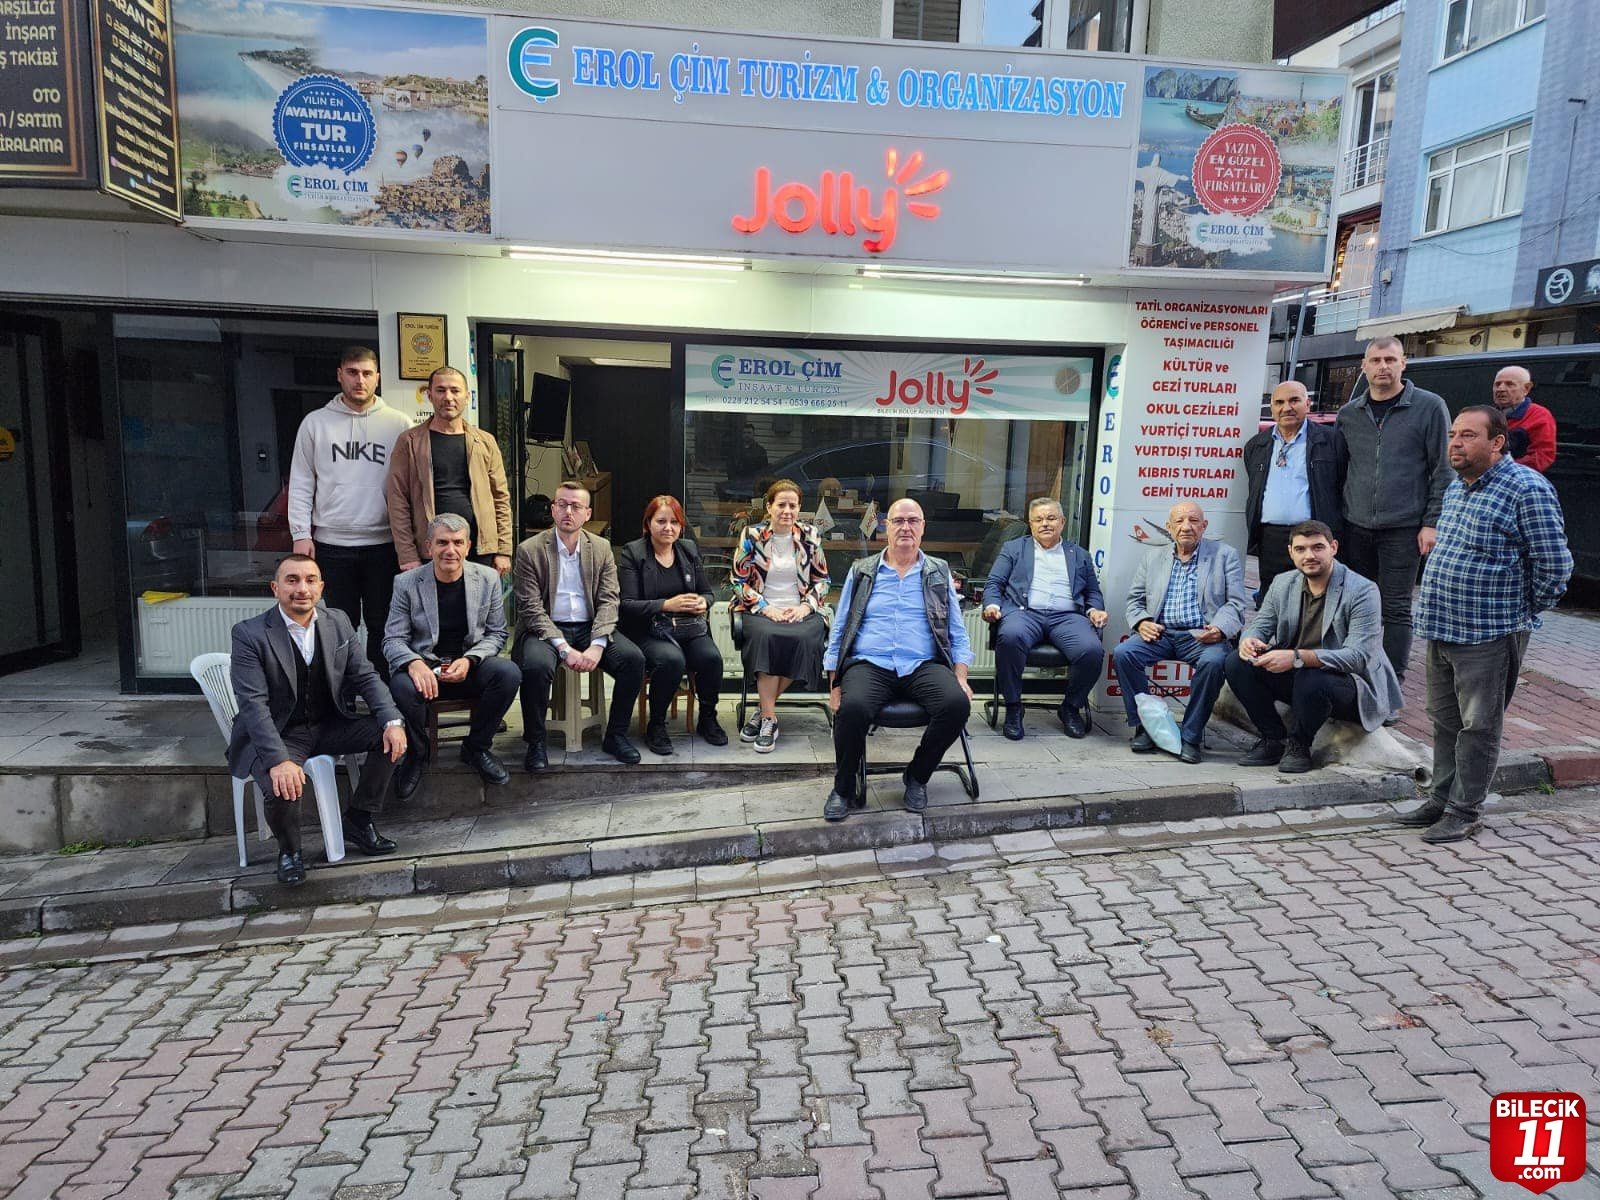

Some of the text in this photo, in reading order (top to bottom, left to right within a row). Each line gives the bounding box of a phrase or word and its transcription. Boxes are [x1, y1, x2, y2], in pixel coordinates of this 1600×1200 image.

[9, 46, 58, 66] TAKİBİ
[572, 41, 1126, 119] EROL ÇİM TURİZM & ORGANİZASYON
[32, 87, 61, 103] OTO
[330, 98, 344, 107] EN
[301, 122, 347, 142] TUR
[293, 141, 356, 154] FIRSATLARI
[1225, 142, 1257, 154] YAZIN
[1210, 154, 1266, 167] EN GÜZEL
[1214, 166, 1260, 179] TATİL
[303, 177, 369, 194] EROL ÇİM
[1205, 180, 1267, 193] FIRSATLARI
[731, 166, 899, 253] Jolly
[1210, 223, 1264, 238] EROL ÇİM
[1136, 299, 1268, 315] TATİL ORGANİZASYONLARI
[1141, 317, 1259, 332] ÖĞRENCİ ve PERSONEL
[1164, 337, 1234, 349] TAŞIMACILIĞI
[739, 358, 842, 381] EROL ÇİM
[1163, 357, 1229, 373] KÜLTÜR ve
[875, 370, 970, 415] Jolly
[1152, 378, 1237, 394] GEZİ TURLARI
[1146, 401, 1239, 416] OKUL GEZİLERİ
[1141, 422, 1241, 440] YURTİÇİ TURLAR
[332, 441, 386, 466] NIKE
[1135, 445, 1243, 460] YURTDIŞI TURLAR
[1138, 467, 1235, 479] KIBRIS TURLARI
[1142, 484, 1228, 498] GEMİ TURLARI
